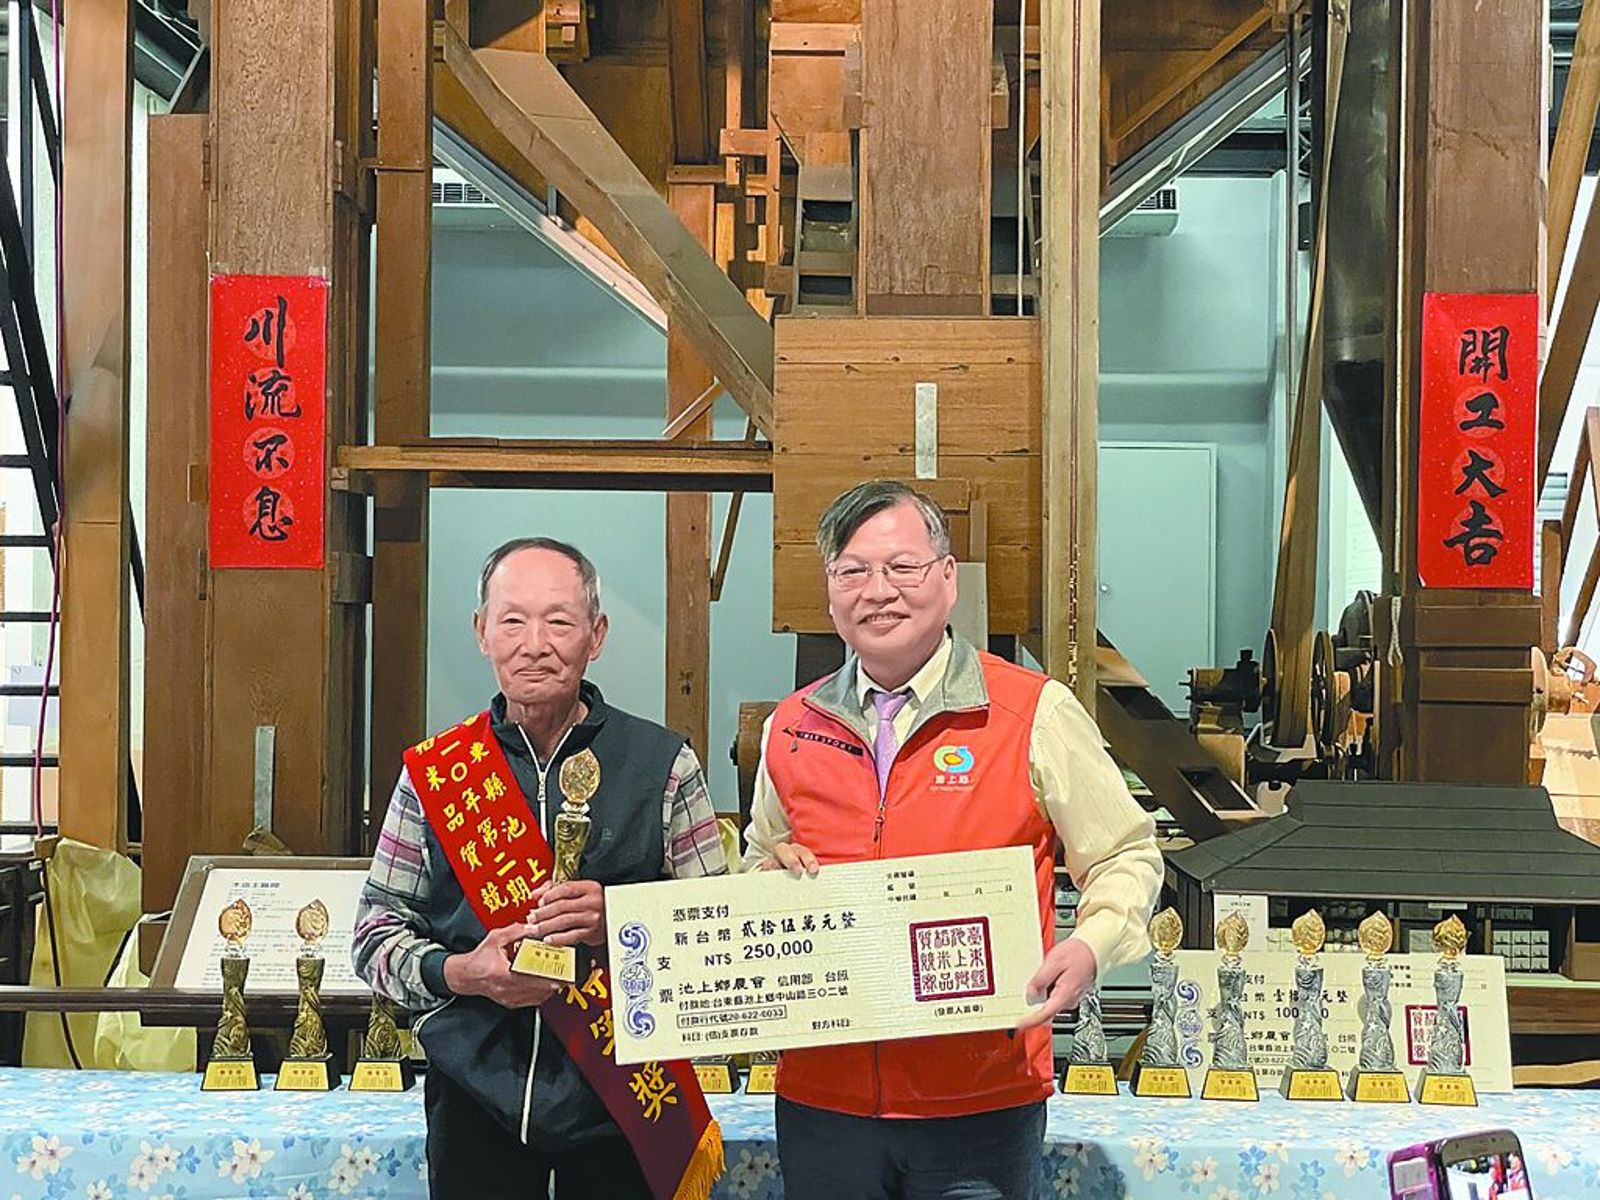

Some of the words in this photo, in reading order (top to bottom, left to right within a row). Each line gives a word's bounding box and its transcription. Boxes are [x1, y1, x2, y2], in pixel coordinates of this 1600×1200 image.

[244, 295, 302, 542] 川流不息
[1443, 325, 1510, 566] 開工大吉
[463, 715, 546, 883] 東縣池上
[673, 905, 729, 922] 憑票支付
[743, 939, 813, 961] 250,000
[679, 976, 765, 996] 池上鄉農會
[1275, 1006, 1329, 1018] 1000
